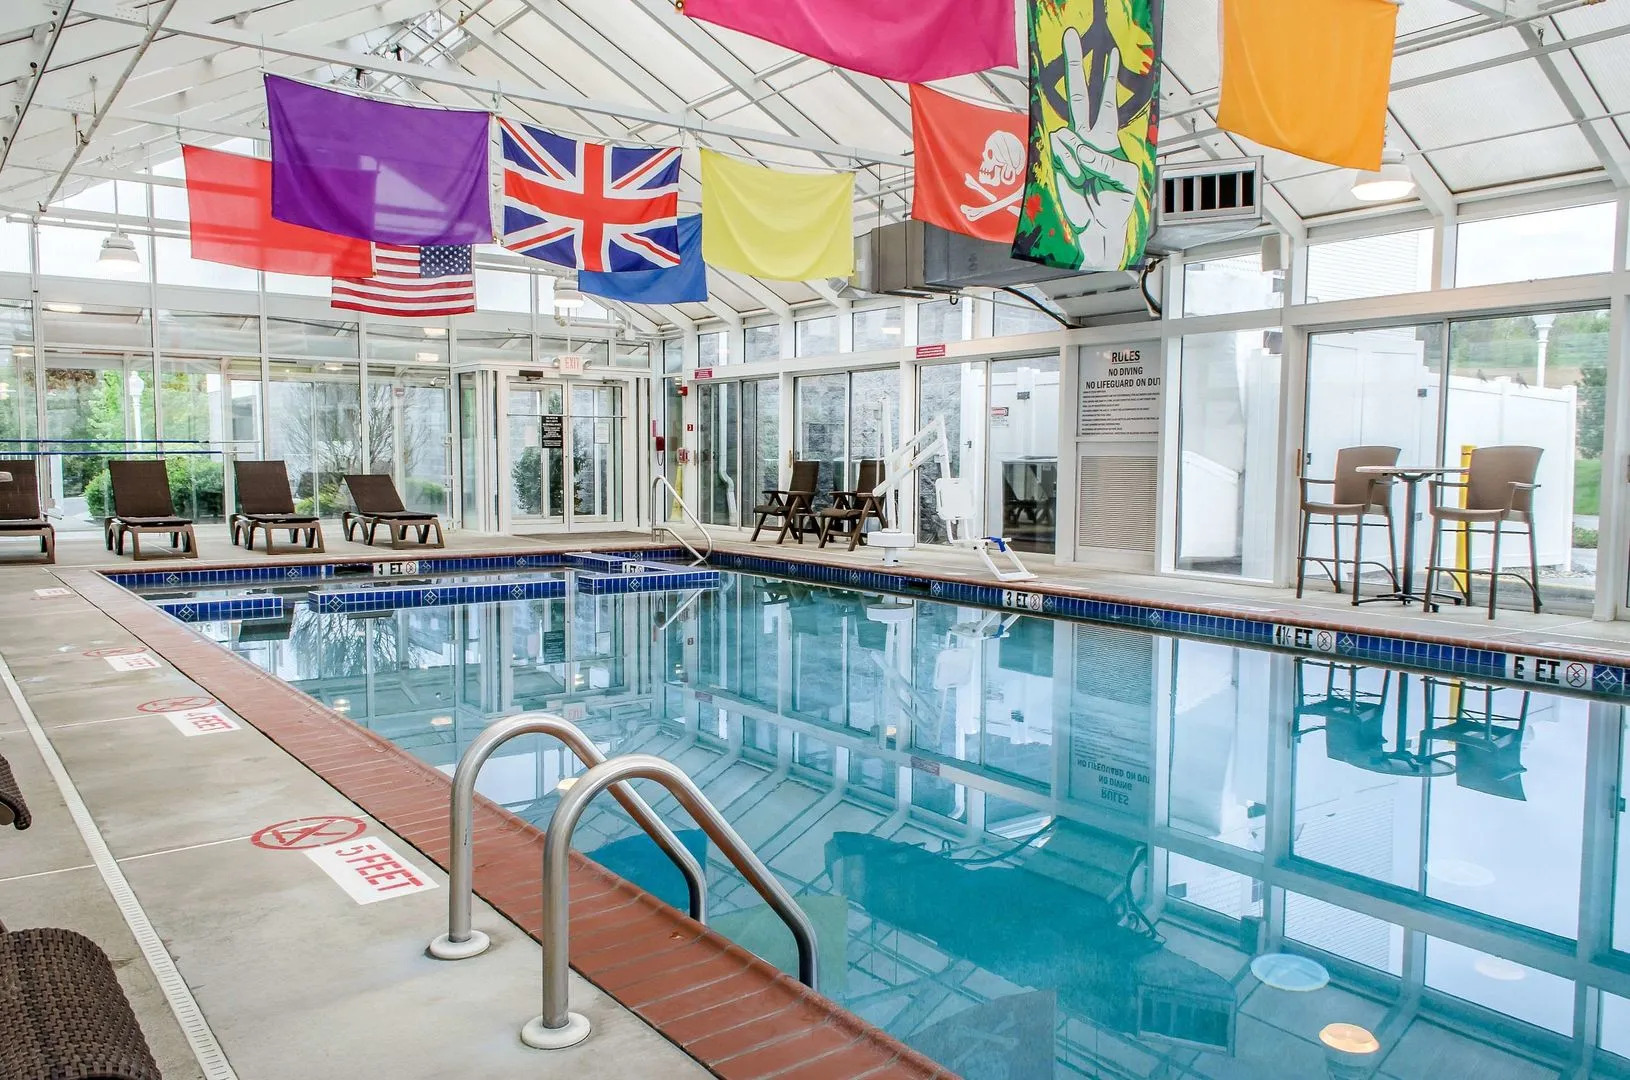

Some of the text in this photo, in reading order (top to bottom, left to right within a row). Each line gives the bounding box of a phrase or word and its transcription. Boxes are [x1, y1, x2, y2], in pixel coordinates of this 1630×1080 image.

[565, 357, 580, 369] EXIT
[1111, 350, 1141, 363] RULES
[1108, 366, 1143, 377] NO DIVING
[1085, 377, 1161, 390] NO LIFEGUARD ON DUT
[335, 843, 425, 892] 5 FEET
